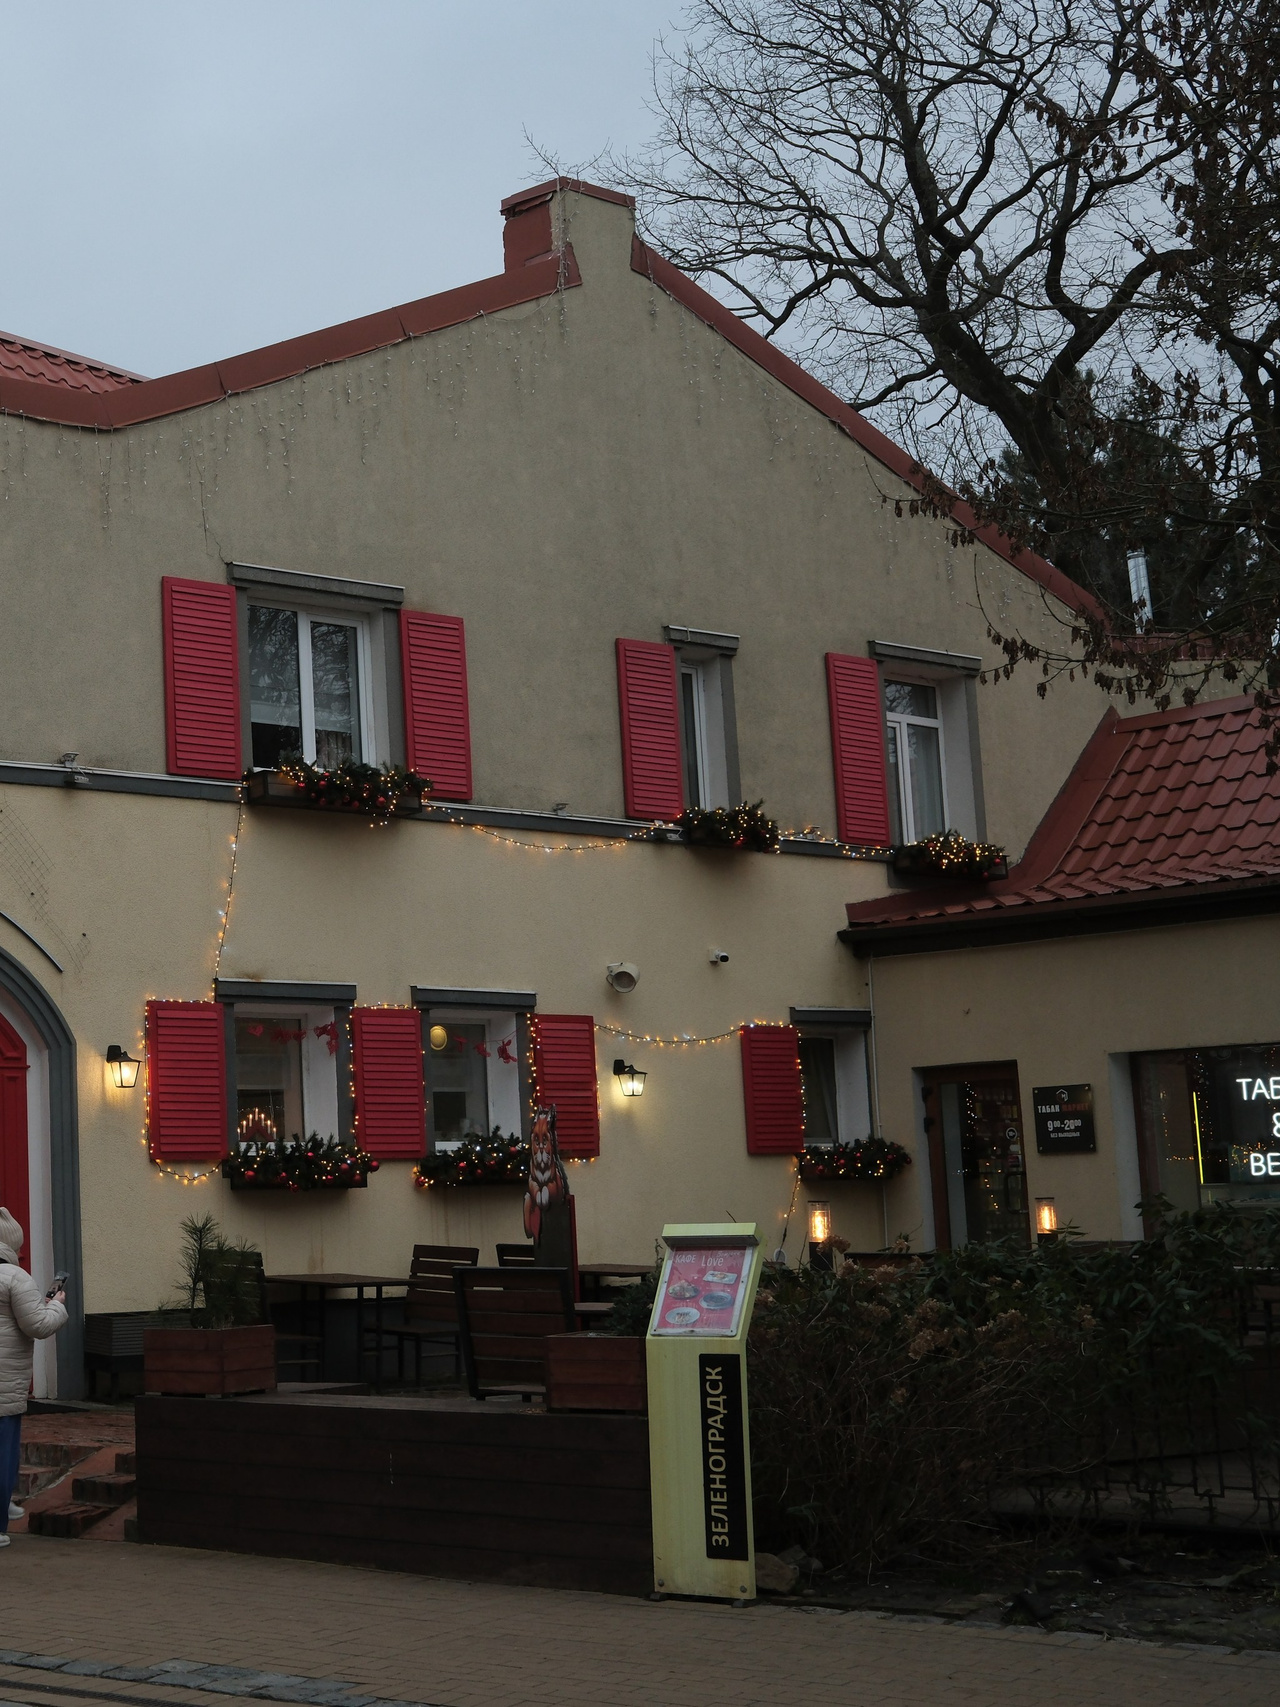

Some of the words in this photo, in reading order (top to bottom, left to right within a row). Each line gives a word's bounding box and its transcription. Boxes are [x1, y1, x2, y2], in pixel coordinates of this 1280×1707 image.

[675, 1254, 697, 1264] КАФЕ
[701, 1254, 724, 1267] Love
[706, 1366, 729, 1547] ЗЕЛЕНОГРАДСК
